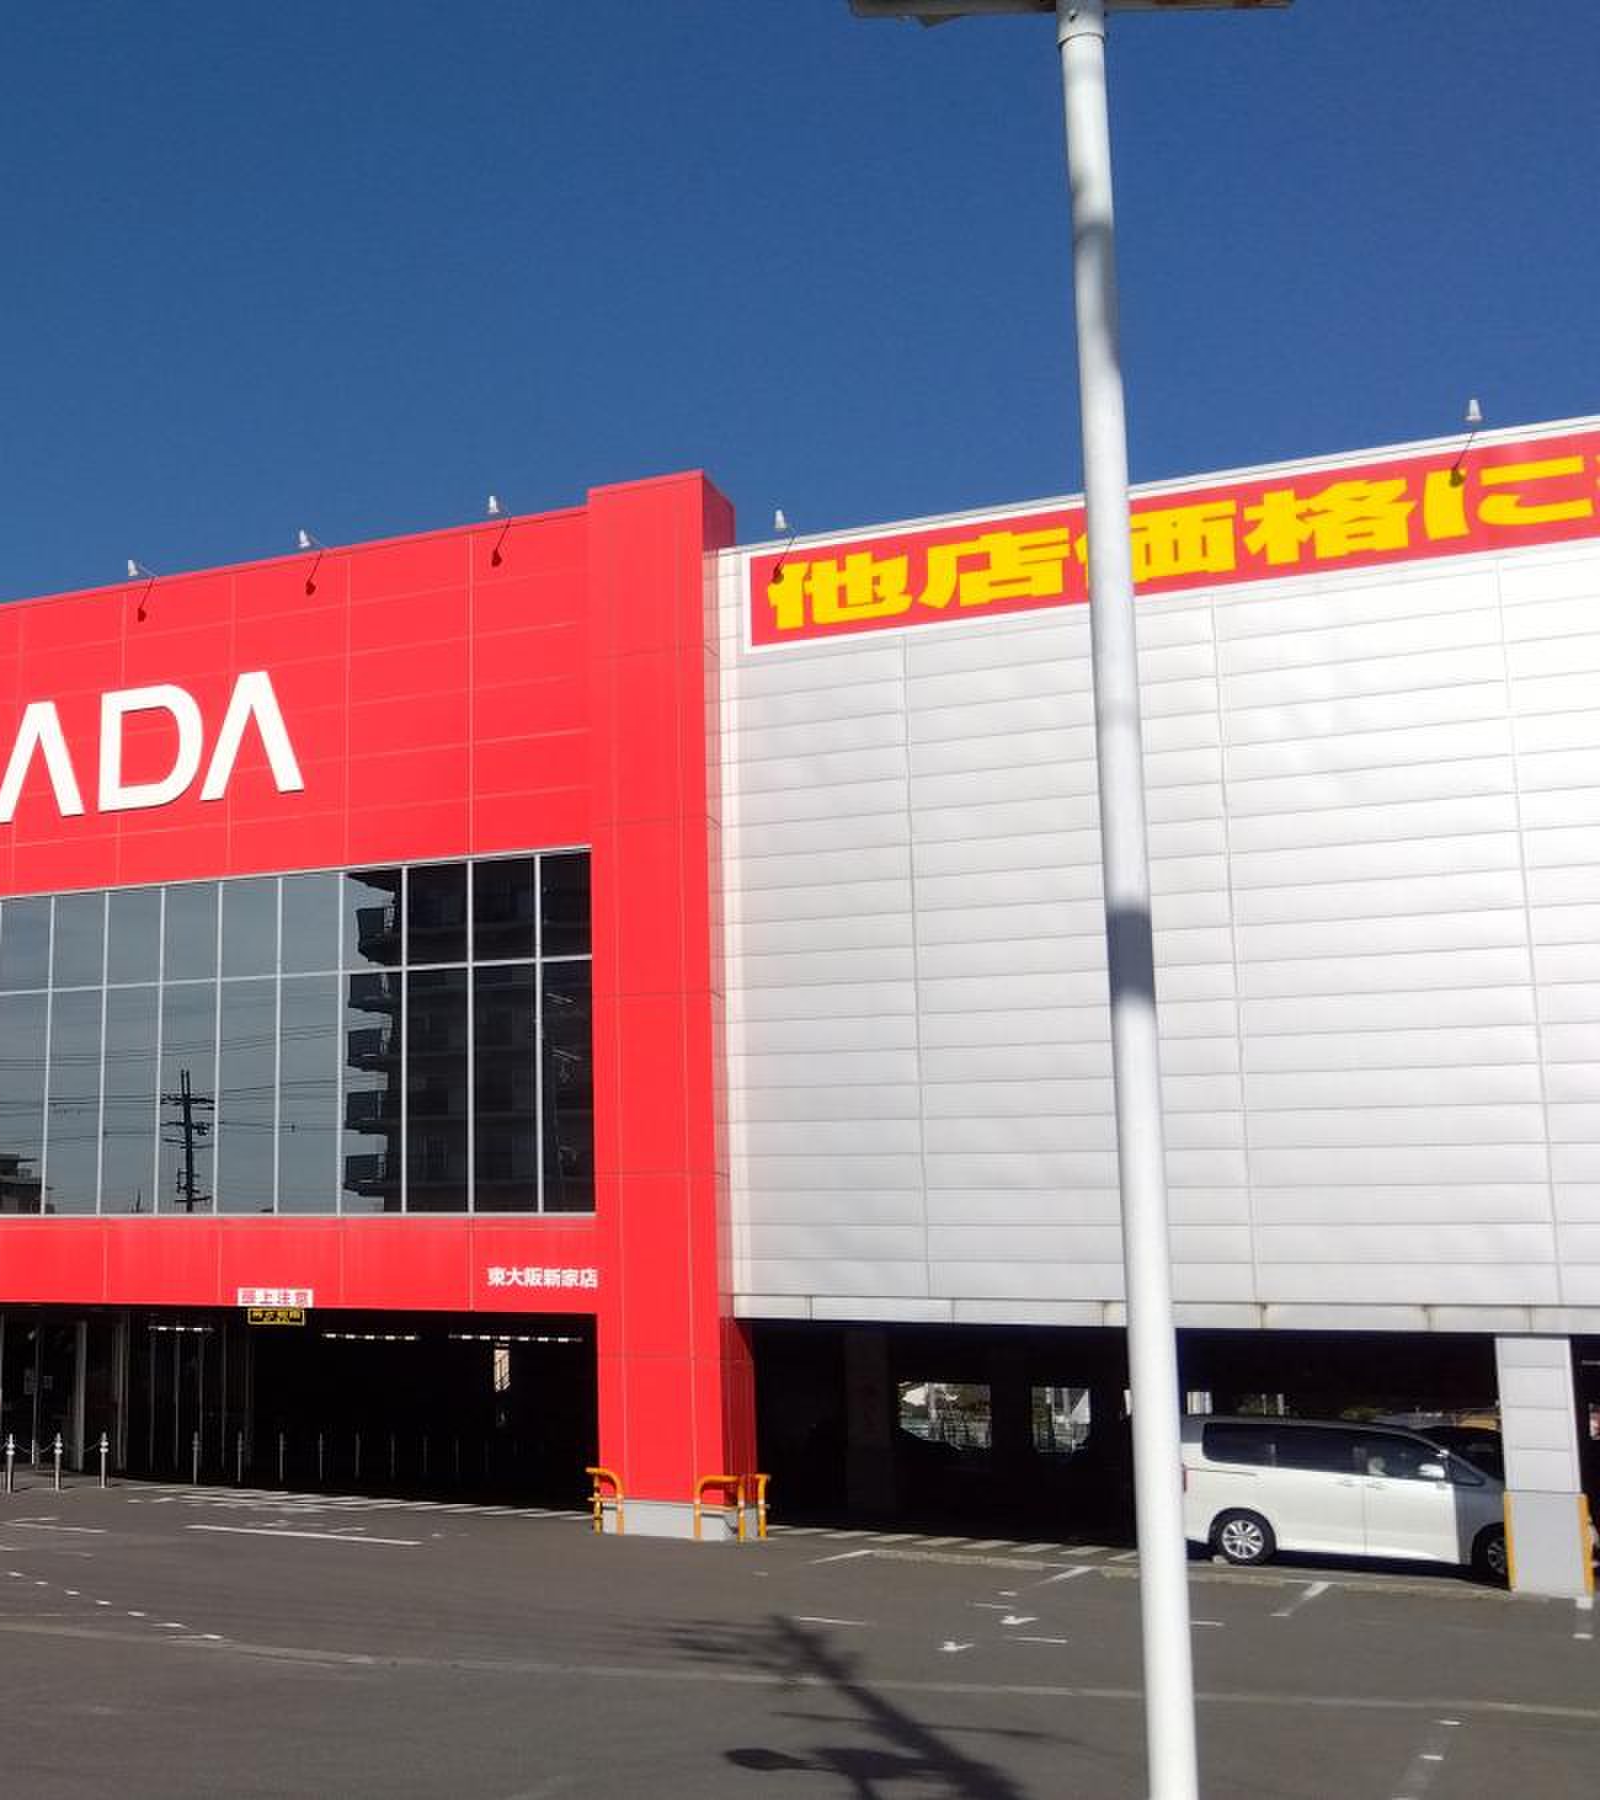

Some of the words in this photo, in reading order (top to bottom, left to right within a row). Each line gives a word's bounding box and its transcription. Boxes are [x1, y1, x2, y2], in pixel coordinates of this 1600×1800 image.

[767, 454, 1600, 631] 他店価格に
